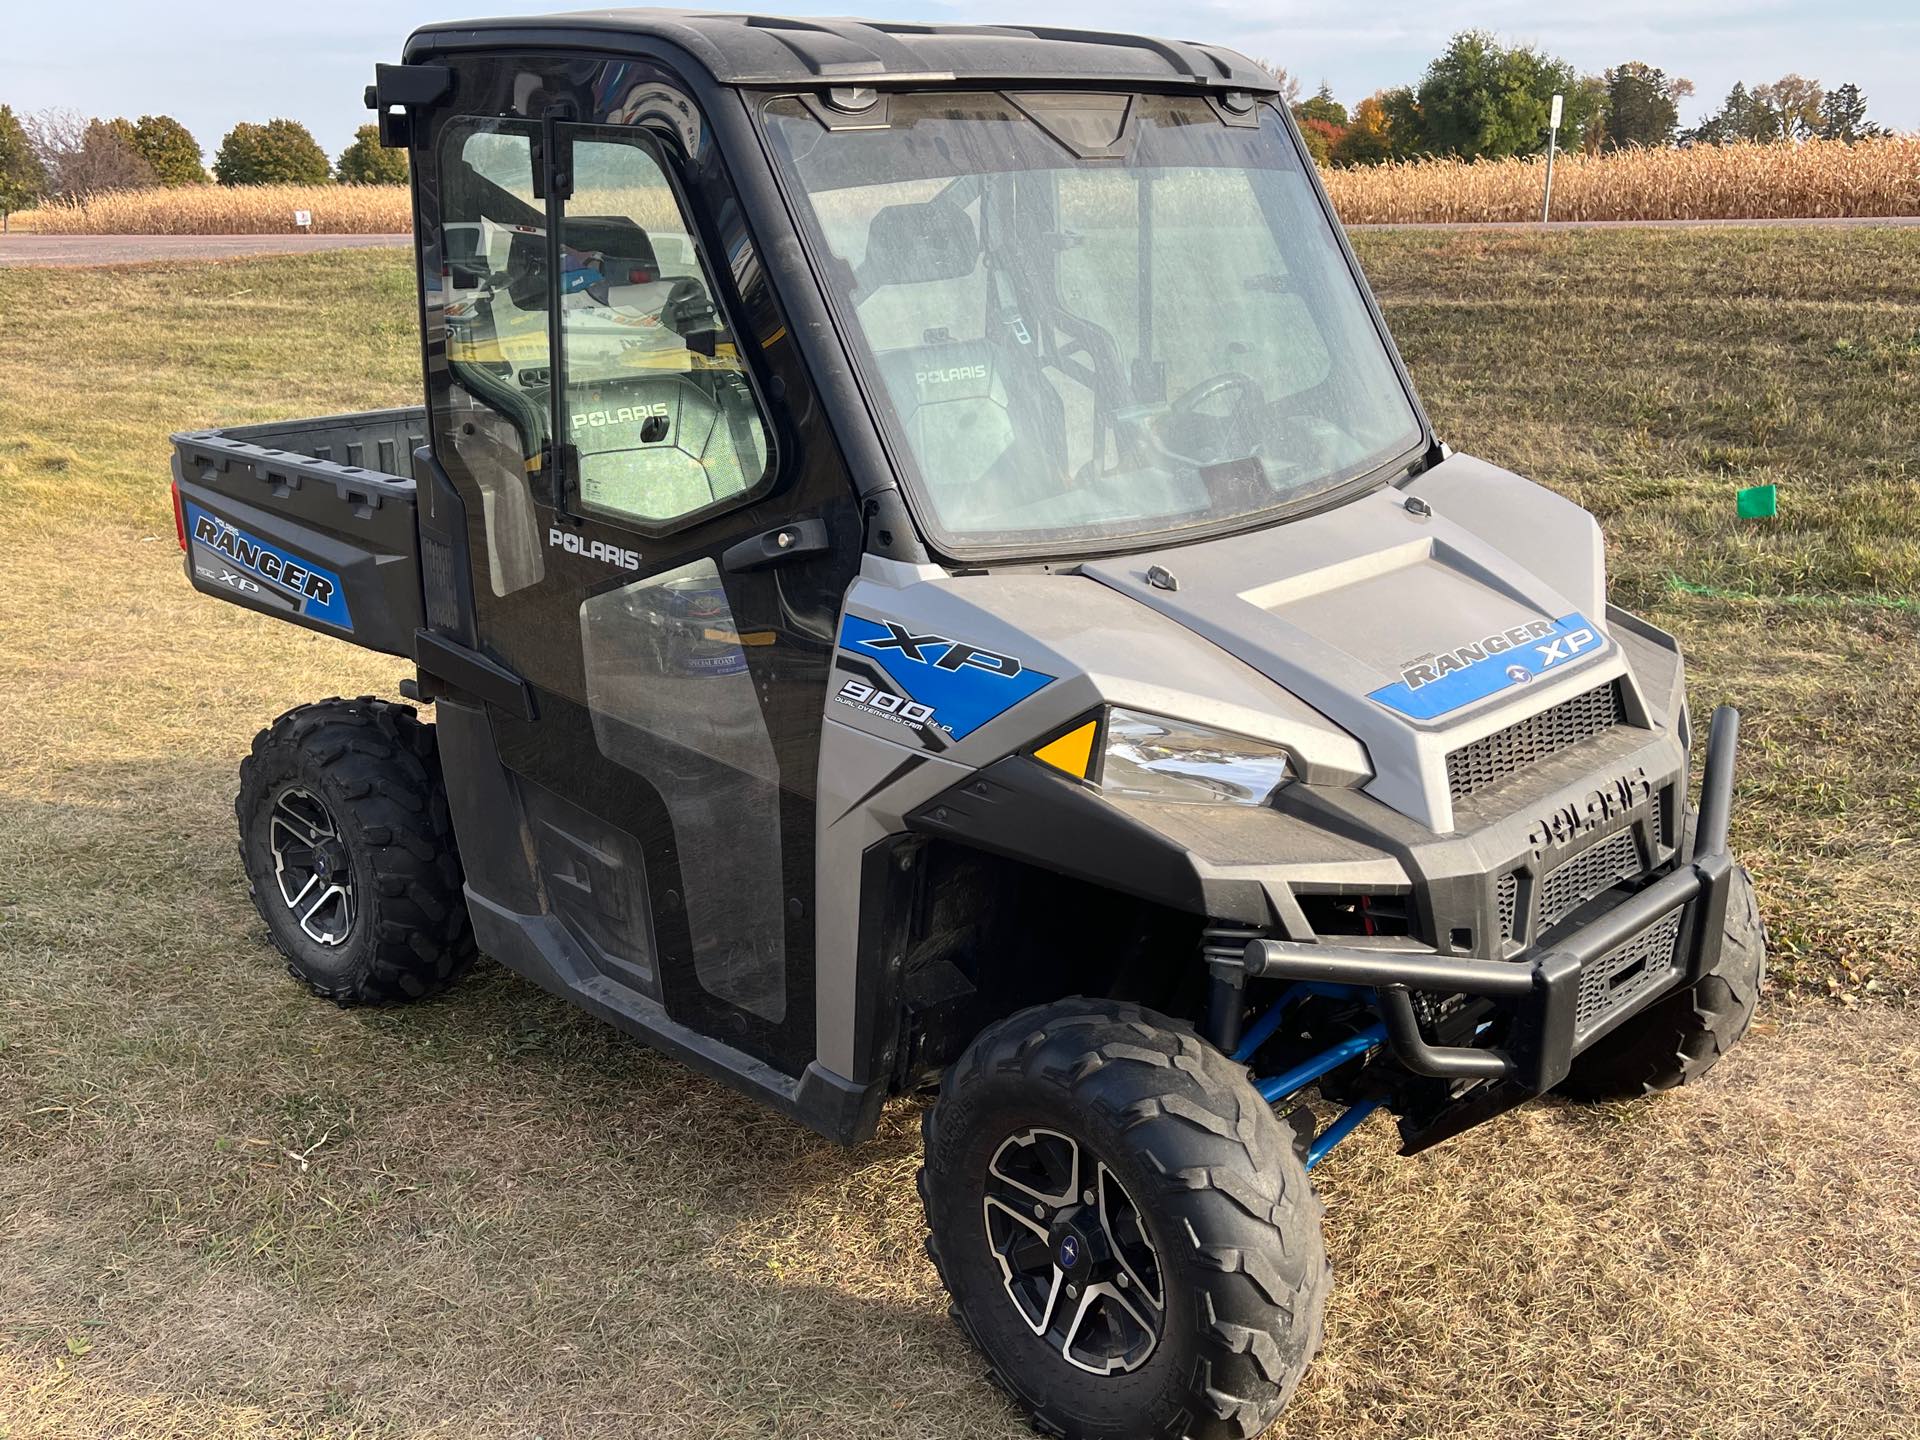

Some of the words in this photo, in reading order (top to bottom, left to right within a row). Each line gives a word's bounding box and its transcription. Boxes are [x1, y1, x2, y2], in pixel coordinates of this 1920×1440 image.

[915, 364, 986, 385] POLARIS
[571, 403, 668, 429] POLARIS
[194, 515, 334, 606] RANGER
[549, 528, 641, 571] POLARIS
[219, 569, 259, 593] XP
[713, 656, 736, 665] ROAST
[856, 618, 1022, 679] XP
[1400, 620, 1557, 691] RANGER
[1535, 628, 1594, 667] XP
[834, 696, 855, 708] DUAL
[857, 704, 903, 722] OVERHEAD
[902, 719, 923, 731] CAM
[839, 680, 937, 723] 900
[1528, 766, 1651, 862] POLARIS
